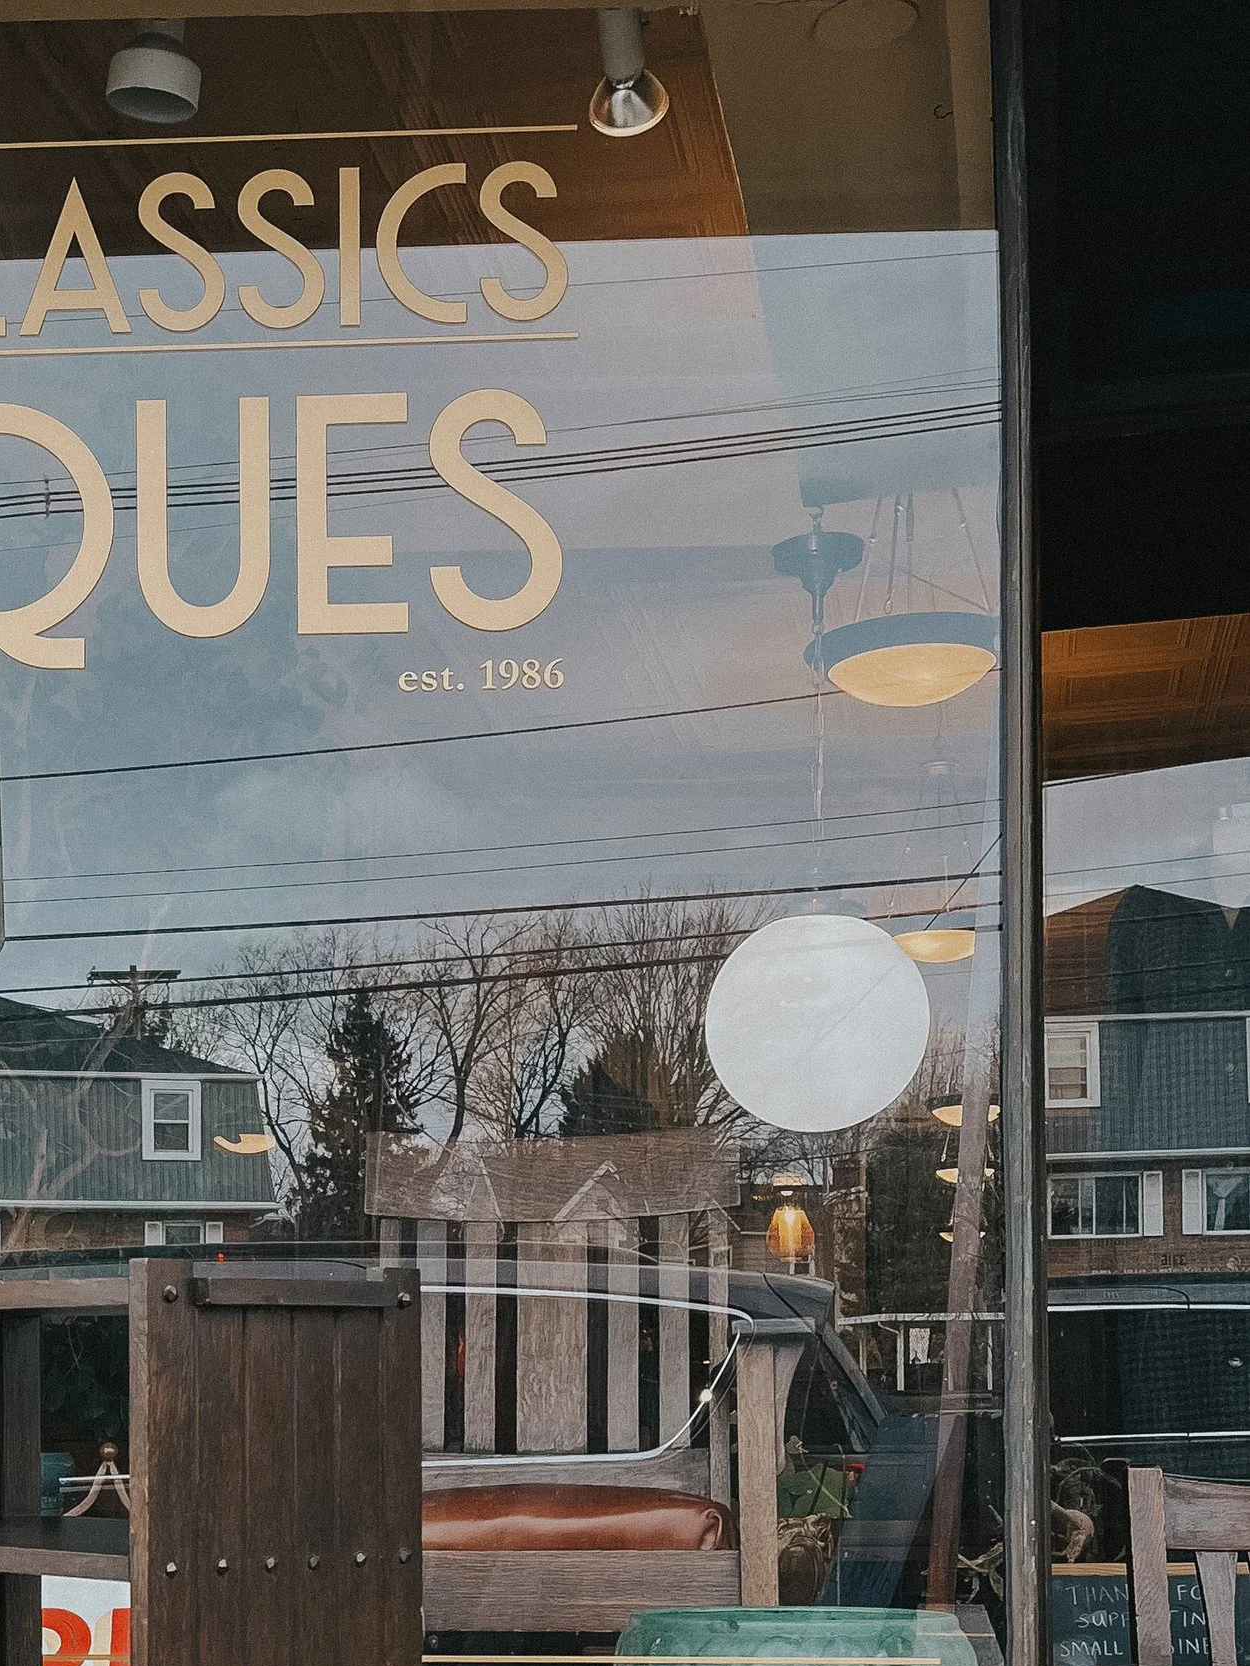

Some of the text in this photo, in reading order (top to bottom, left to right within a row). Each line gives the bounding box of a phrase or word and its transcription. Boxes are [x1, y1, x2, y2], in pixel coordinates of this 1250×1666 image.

[397, 657, 566, 692] est. 1986
[1065, 1583, 1129, 1605] THAN
[1060, 1640, 1124, 1657] SMALL
